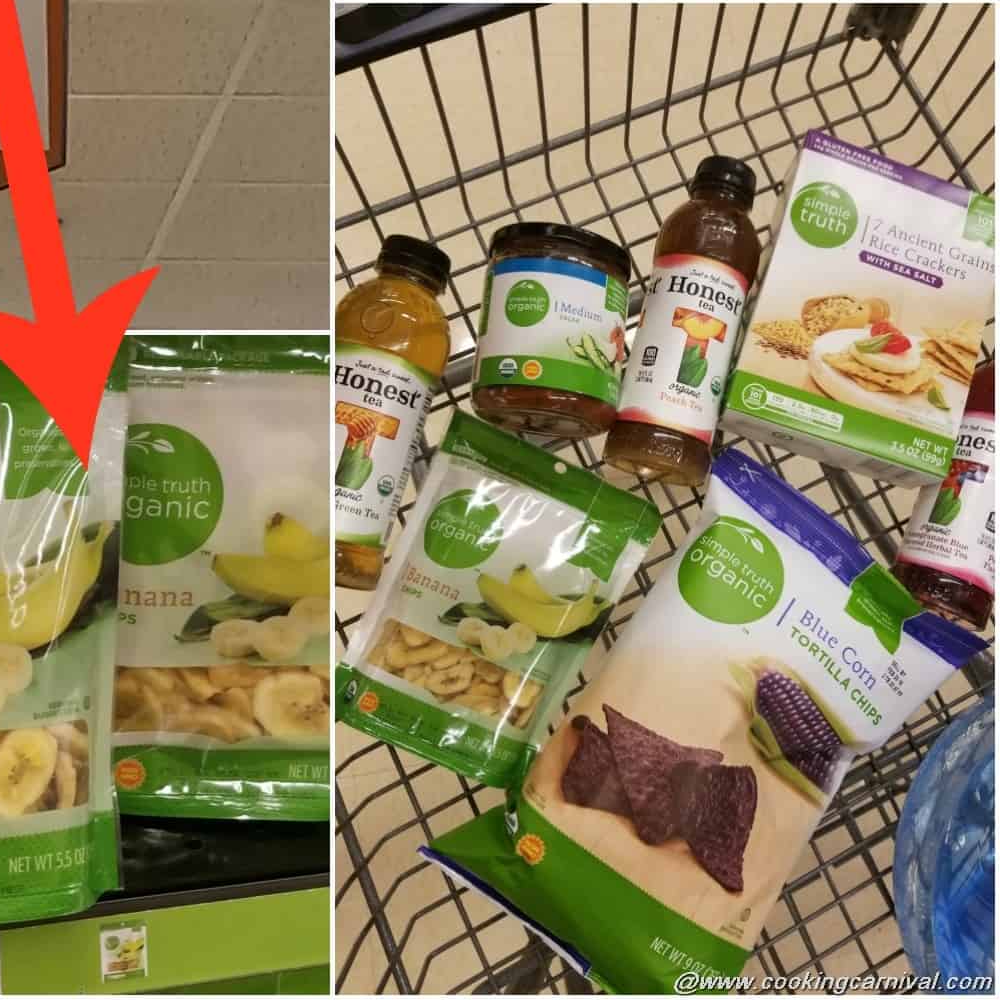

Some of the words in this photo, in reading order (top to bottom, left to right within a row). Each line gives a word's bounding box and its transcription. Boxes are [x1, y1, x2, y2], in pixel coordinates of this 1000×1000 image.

[801, 208, 847, 236] truth
[803, 196, 850, 221] simple
[869, 235, 900, 257] Rice
[904, 248, 968, 280] Crackers
[888, 224, 944, 256] Ancient
[949, 246, 995, 275] Grains
[866, 254, 891, 270] WITH
[893, 261, 912, 276] SEA
[913, 270, 937, 285] SALT
[508, 303, 545, 313] organic
[667, 275, 742, 315] Honest
[699, 299, 715, 312] tea
[561, 302, 602, 320] Medium
[335, 365, 421, 409] Honest
[363, 393, 383, 408] tea
[913, 437, 931, 450] NET
[956, 434, 995, 453] nes
[162, 477, 211, 494] truth
[364, 506, 380, 521] Tea
[430, 519, 489, 552] organc
[690, 548, 767, 609] organic
[700, 535, 741, 568] simple
[742, 563, 775, 595] truth
[405, 566, 460, 601] Banana
[799, 609, 840, 649] Blue
[841, 646, 878, 691] Corn
[791, 626, 851, 692] TORTILLA
[850, 688, 882, 727] CHIPS
[288, 763, 308, 777] NET
[9, 856, 31, 873] NET
[35, 854, 54, 873] WT
[56, 851, 73, 870] 5.5
[650, 936, 672, 956] NET
[668, 947, 688, 966] WT
